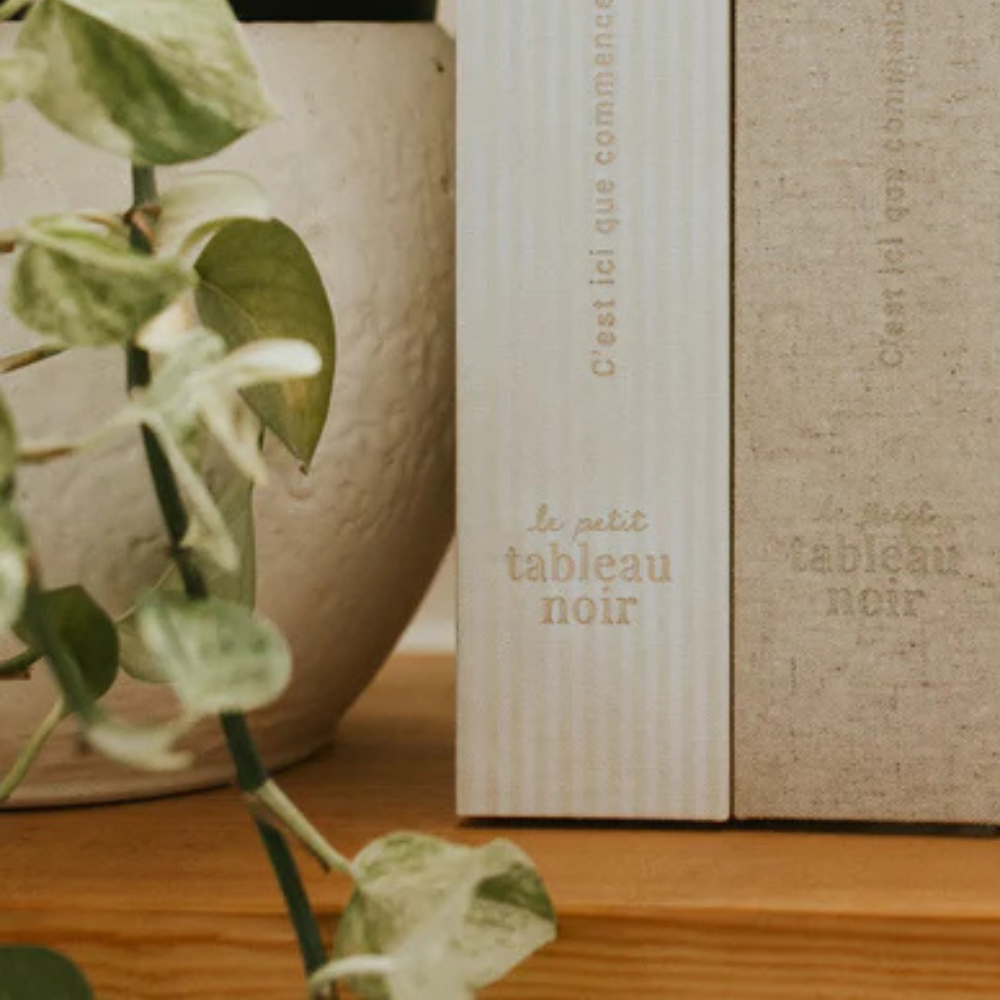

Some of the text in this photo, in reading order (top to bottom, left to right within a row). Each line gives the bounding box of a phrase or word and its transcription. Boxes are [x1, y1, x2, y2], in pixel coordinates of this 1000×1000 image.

[594, 178, 622, 236] que
[589, 249, 616, 285] ici
[591, 298, 617, 377] C'est
[526, 502, 650, 541] le petit
[504, 541, 673, 583] tableau
[790, 533, 961, 575] tableau
[540, 586, 640, 625] noir
